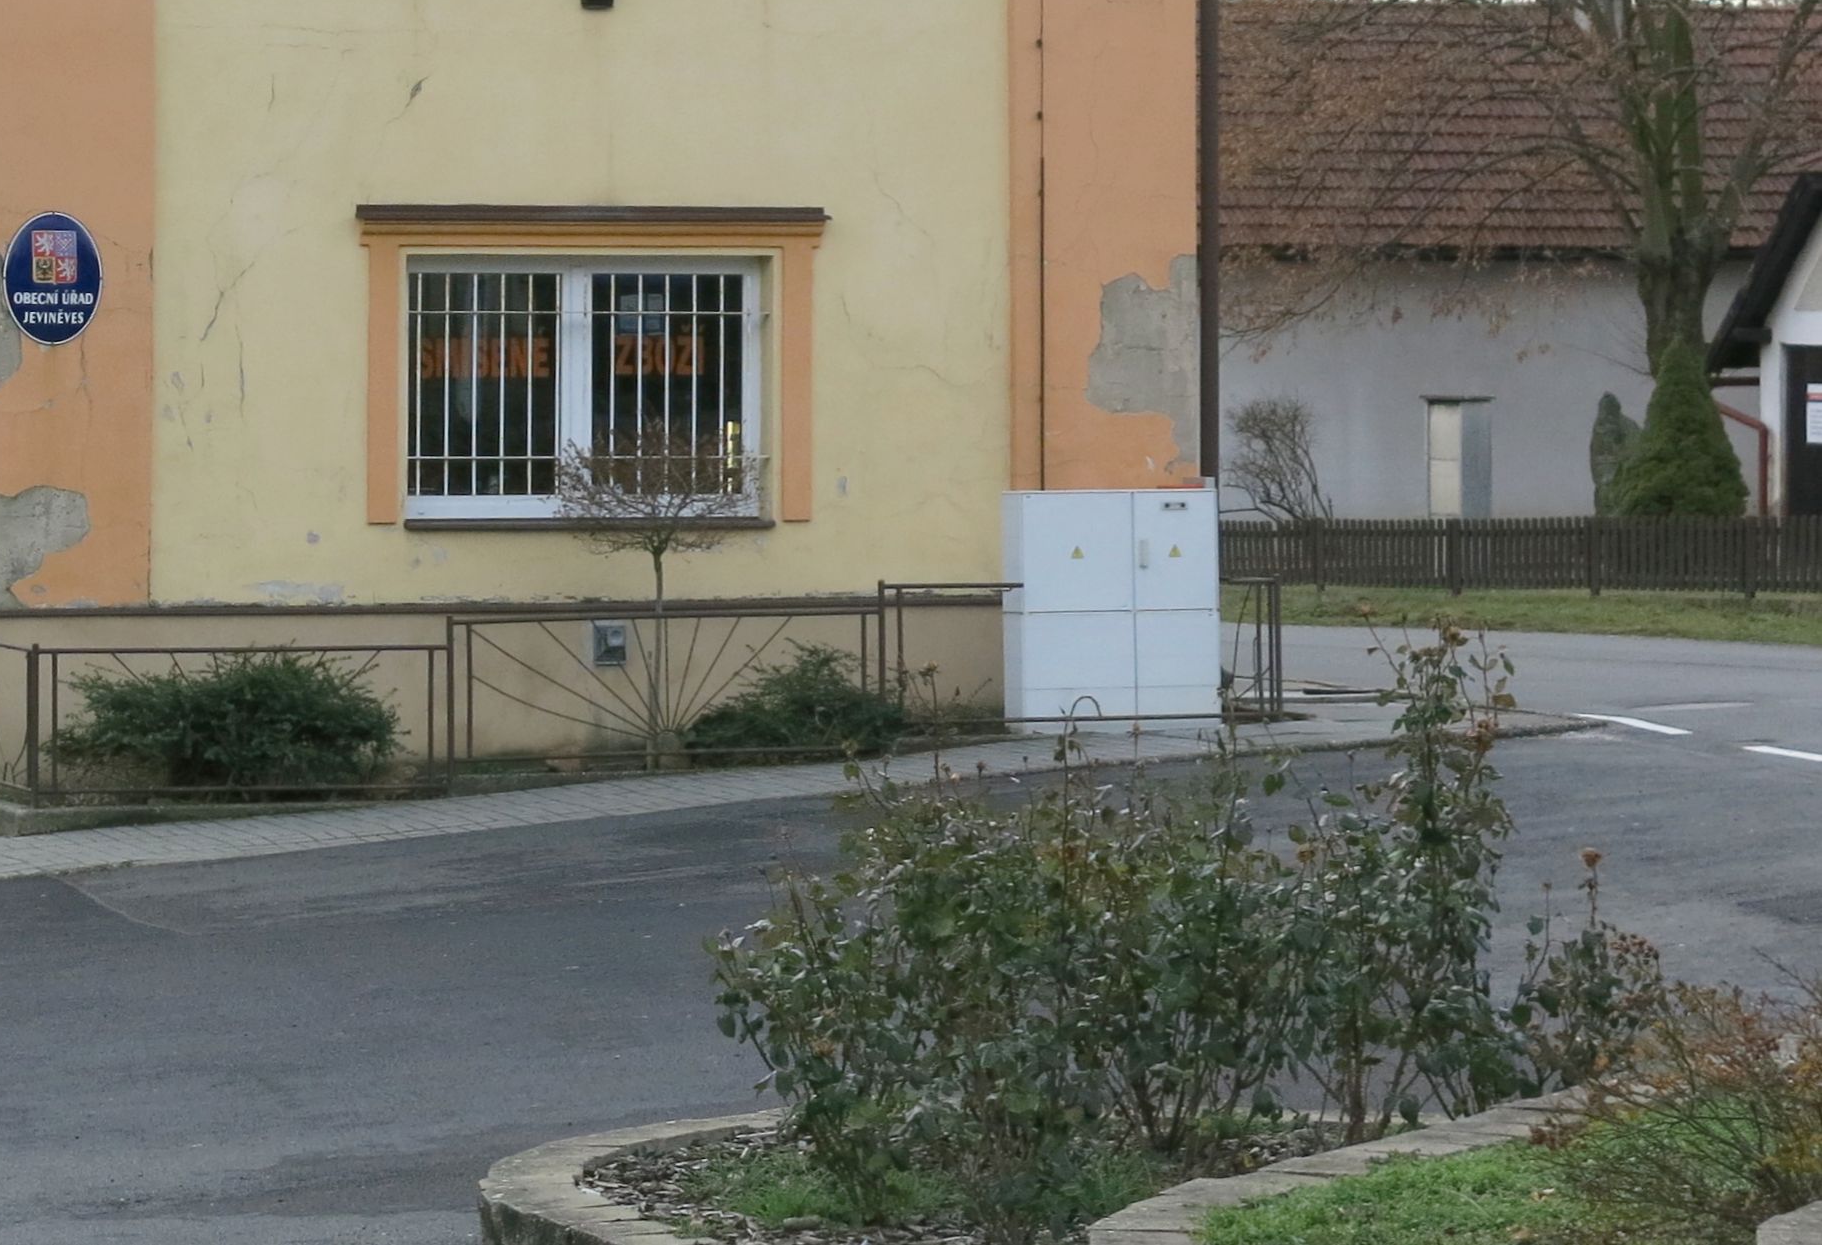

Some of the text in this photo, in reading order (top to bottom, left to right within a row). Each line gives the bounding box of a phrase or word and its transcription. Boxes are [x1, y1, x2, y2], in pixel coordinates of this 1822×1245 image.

[13, 289, 94, 305] OBECNÍ ÚŘAD
[23, 309, 84, 324] JEVINĚVES
